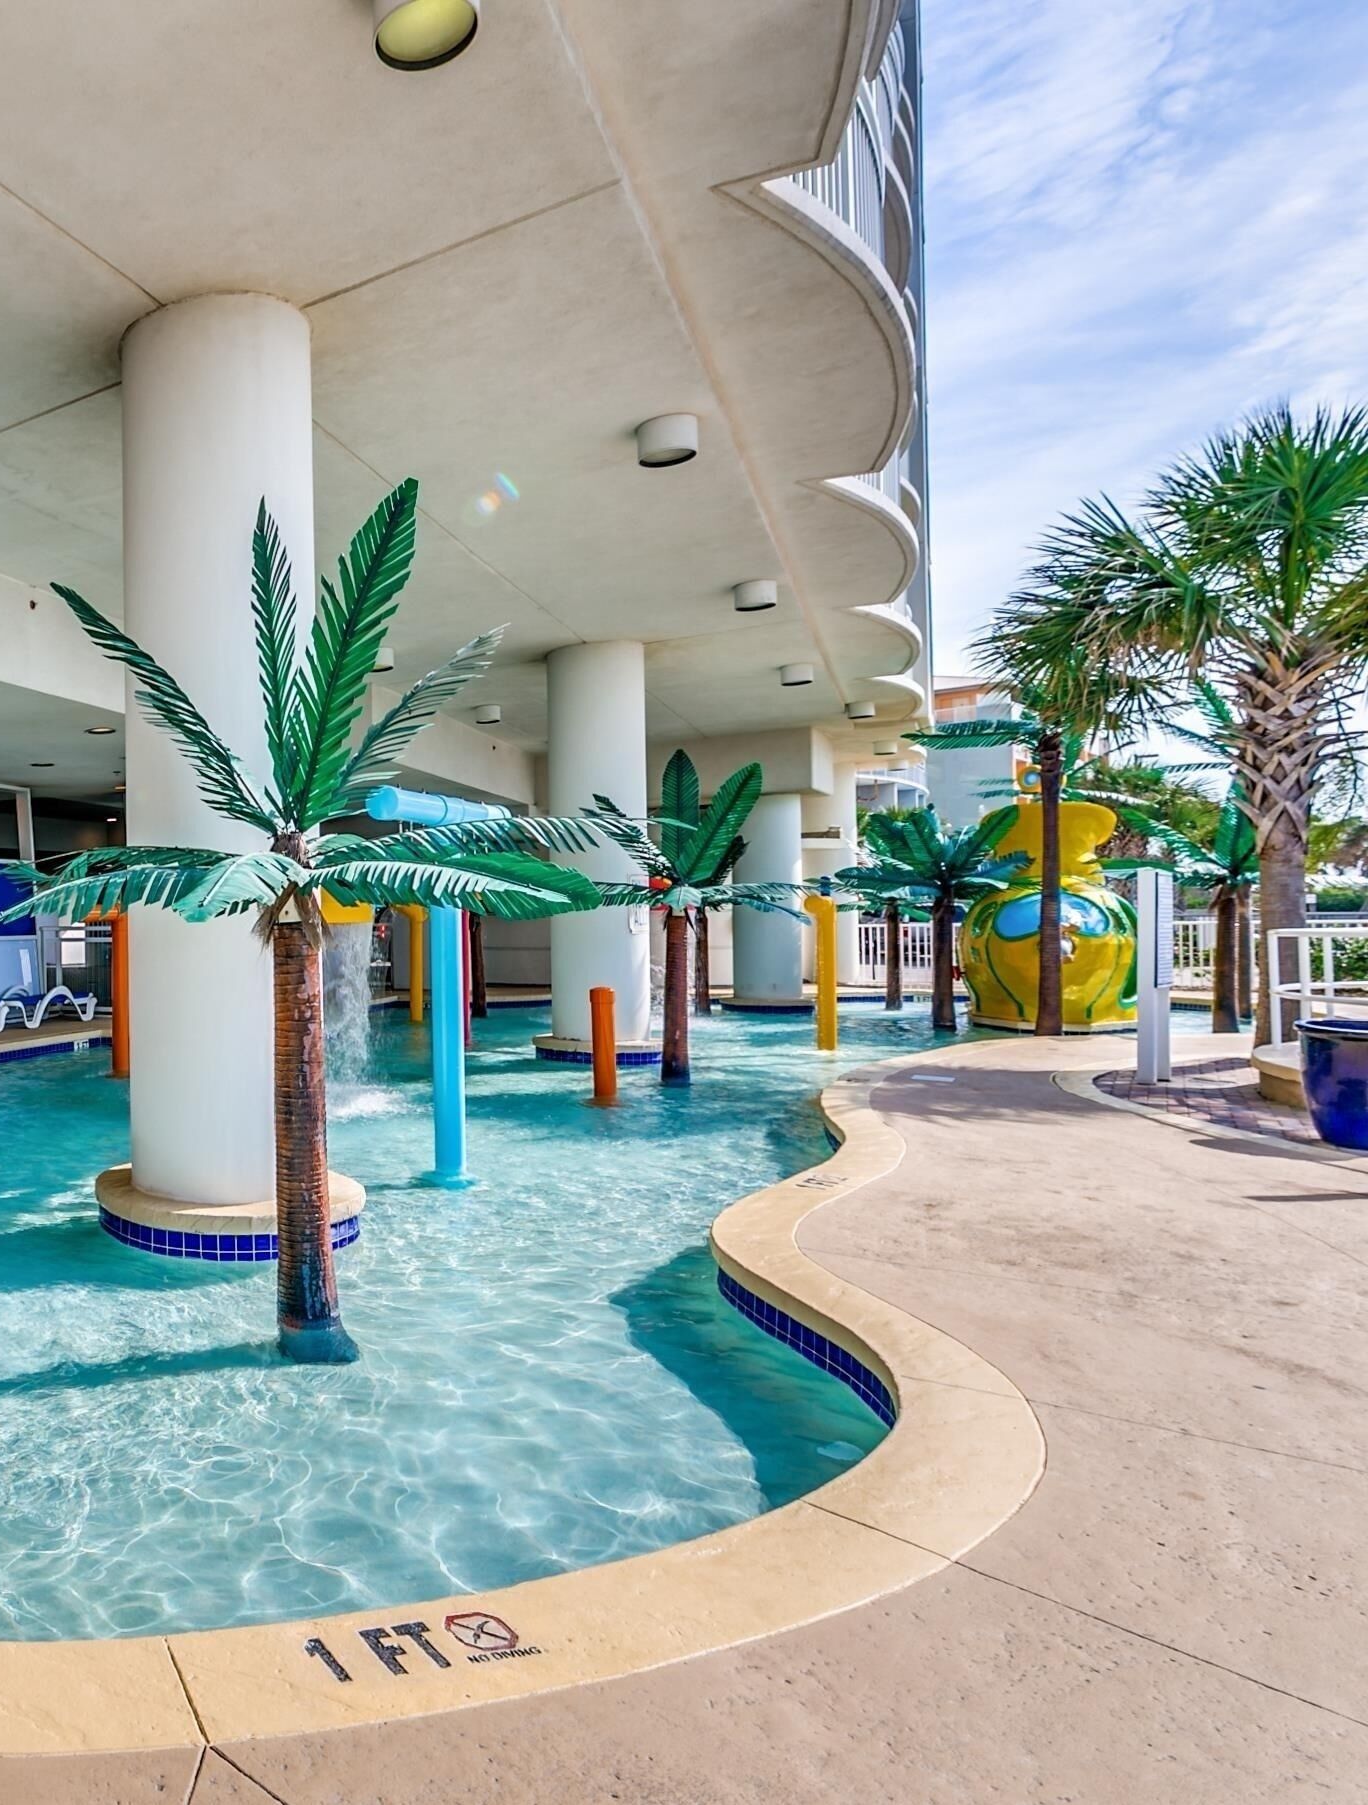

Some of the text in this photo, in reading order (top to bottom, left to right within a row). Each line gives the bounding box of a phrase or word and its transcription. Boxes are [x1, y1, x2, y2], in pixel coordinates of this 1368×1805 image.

[304, 1621, 452, 1683] 1 FT
[467, 1645, 542, 1665] NO DIVING
